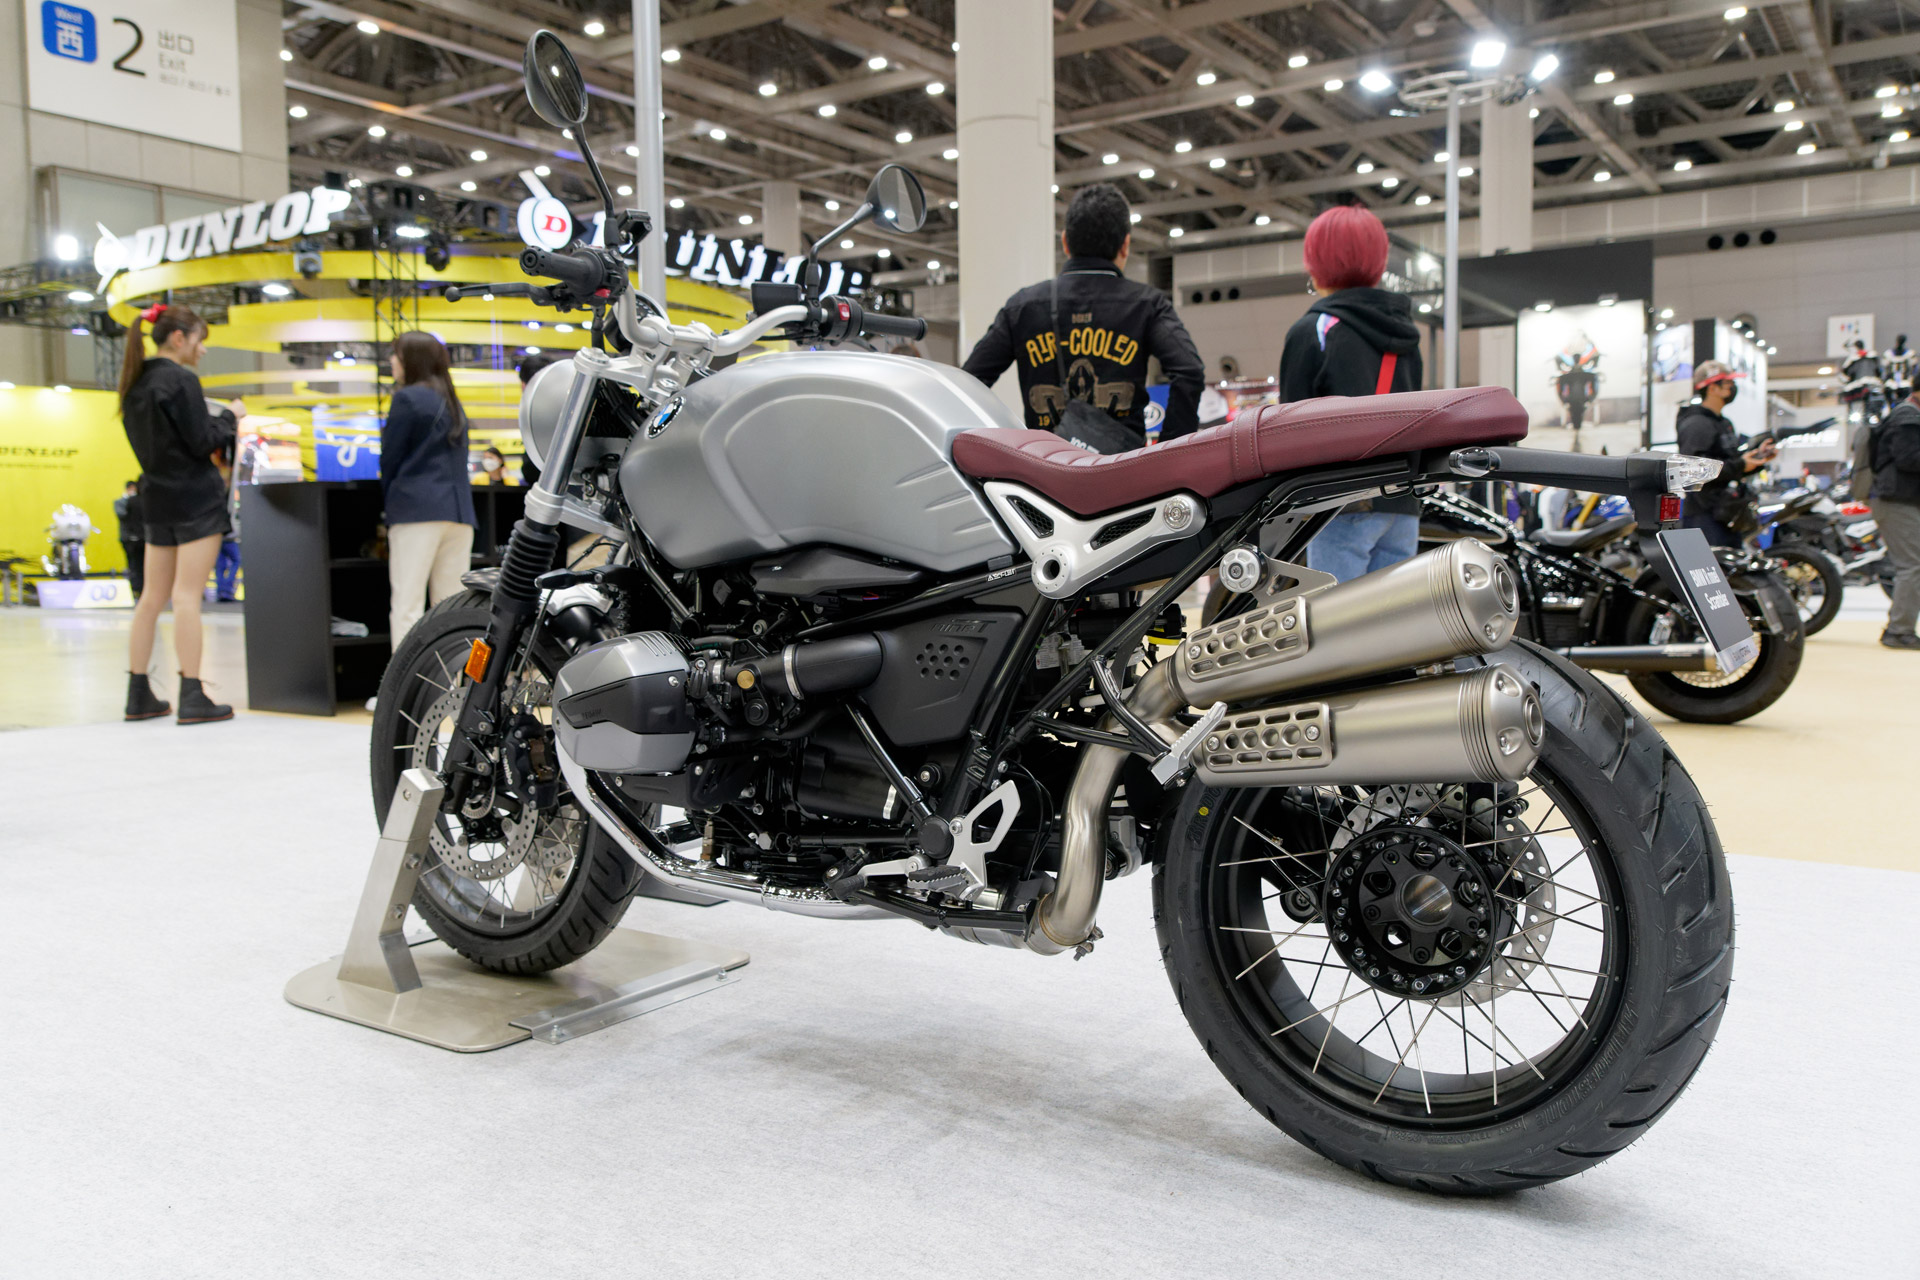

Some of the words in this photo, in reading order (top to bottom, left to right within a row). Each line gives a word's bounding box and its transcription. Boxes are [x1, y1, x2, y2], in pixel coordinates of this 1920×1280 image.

[54, 6, 84, 26] West
[56, 21, 84, 59] 西
[112, 17, 147, 77] 2
[157, 30, 195, 55] 出口
[159, 52, 188, 74] Exit
[127, 185, 353, 272] DUNLOP
[1025, 326, 1139, 368] AIR-COOLED
